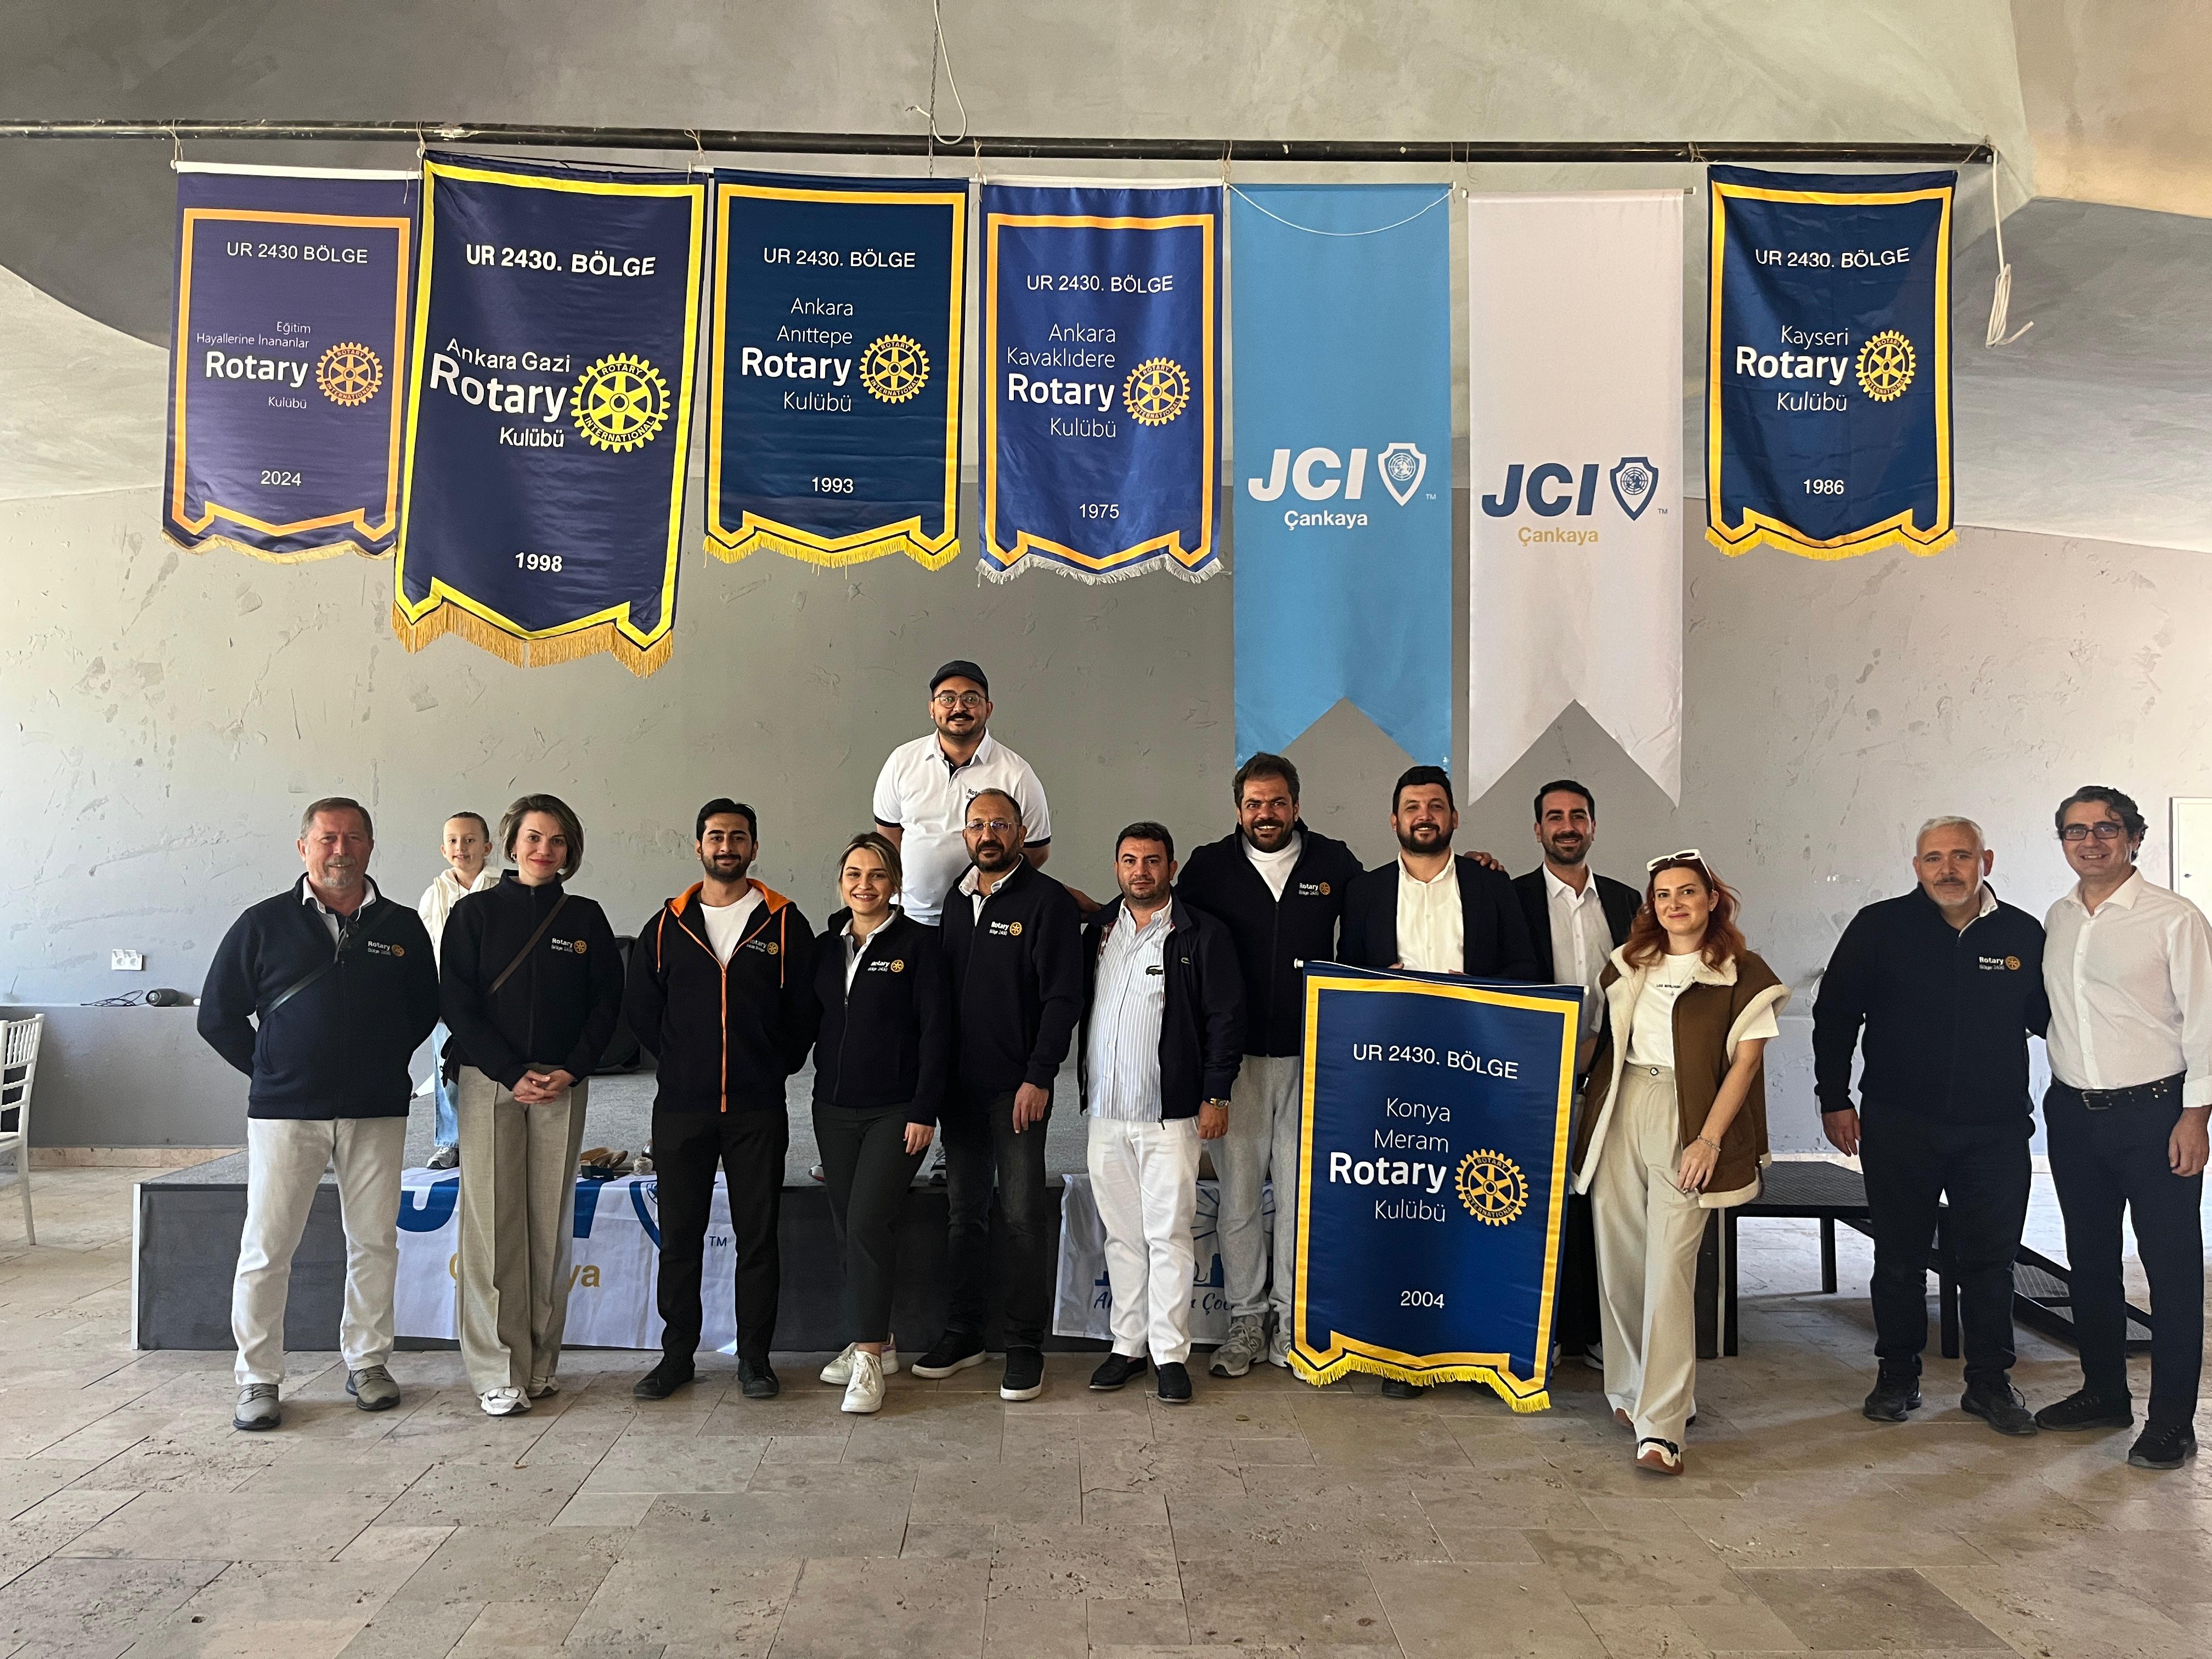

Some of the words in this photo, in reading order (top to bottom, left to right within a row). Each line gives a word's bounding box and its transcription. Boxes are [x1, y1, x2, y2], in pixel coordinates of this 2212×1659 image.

[227, 241, 252, 257] UR
[258, 244, 298, 259] 2430
[303, 245, 368, 263] BÖLGE
[466, 244, 495, 266] UR
[501, 247, 562, 271] 2430.
[571, 250, 656, 276] BÖLGE
[764, 247, 791, 264] UR
[796, 250, 843, 267] 2430.
[850, 248, 916, 268] BÖLGE
[1756, 249, 1782, 266] UR
[1787, 252, 1835, 268] 2430.
[1841, 247, 1910, 268] BÖLGE
[1027, 275, 1053, 291] UR
[1058, 275, 1104, 291] 2430.
[1111, 274, 1173, 294] BÖLGE
[791, 297, 853, 316] Ankara
[276, 321, 311, 335] Eğitim
[776, 325, 853, 348] Anıttepe
[1048, 323, 1115, 343] Ankara
[1781, 325, 1848, 350] Kayseri
[196, 332, 255, 346] Hayallerine
[258, 333, 310, 348] İnananlar
[880, 341, 910, 351] ROTARY
[446, 337, 517, 371] Ankara
[522, 351, 570, 373] Gazi
[1007, 346, 1115, 368] Kavaklıdere
[206, 351, 309, 388] Rotary
[601, 363, 643, 376] ROTARY
[742, 347, 851, 386] Rotary
[1142, 364, 1170, 375] ROTARY
[1736, 346, 1849, 386] Rotary
[326, 382, 374, 400] INTERNATIONAL
[430, 352, 568, 422] Rotary
[870, 379, 919, 396] INTERNATIONAL
[1008, 373, 1115, 412] Rotary
[268, 396, 307, 409] Kulübü
[784, 391, 851, 412] Kulübü
[1134, 399, 1181, 419] INTERNATIONAL
[1777, 391, 1847, 411] Kulübü
[499, 427, 565, 448] Kulübü
[584, 417, 654, 442] INTERNATIONAL
[1051, 417, 1116, 438] Kulübü
[261, 470, 302, 487] 2024
[1248, 447, 1368, 501] JCI
[811, 477, 854, 494] 1993
[1481, 462, 1600, 518] JCI
[1803, 479, 1844, 495] 1986
[1079, 503, 1120, 519] 1975
[1284, 510, 1368, 531] Çankaya
[1517, 527, 1599, 547] Çankaya
[515, 552, 562, 572] 1998
[1299, 882, 1318, 890] Rotary
[991, 921, 1009, 930] Rotary
[368, 940, 390, 951] Rotary
[552, 938, 573, 948] Rotary
[1979, 956, 2004, 965] Rotary
[1353, 1043, 1383, 1061] UR
[1389, 1045, 1440, 1065] 2430.
[1447, 1050, 1519, 1080] BÖLGE
[1387, 1097, 1450, 1125] Konya
[1375, 1129, 1448, 1153] Meram
[1330, 1152, 1447, 1194] Rotary
[1476, 1157, 1508, 1170] ROTARY
[1375, 1198, 1446, 1222] Kulübü
[1465, 1193, 1515, 1218] INTERNATIONAL
[708, 1235, 727, 1248] TM
[1400, 1290, 1444, 1309] 2004
